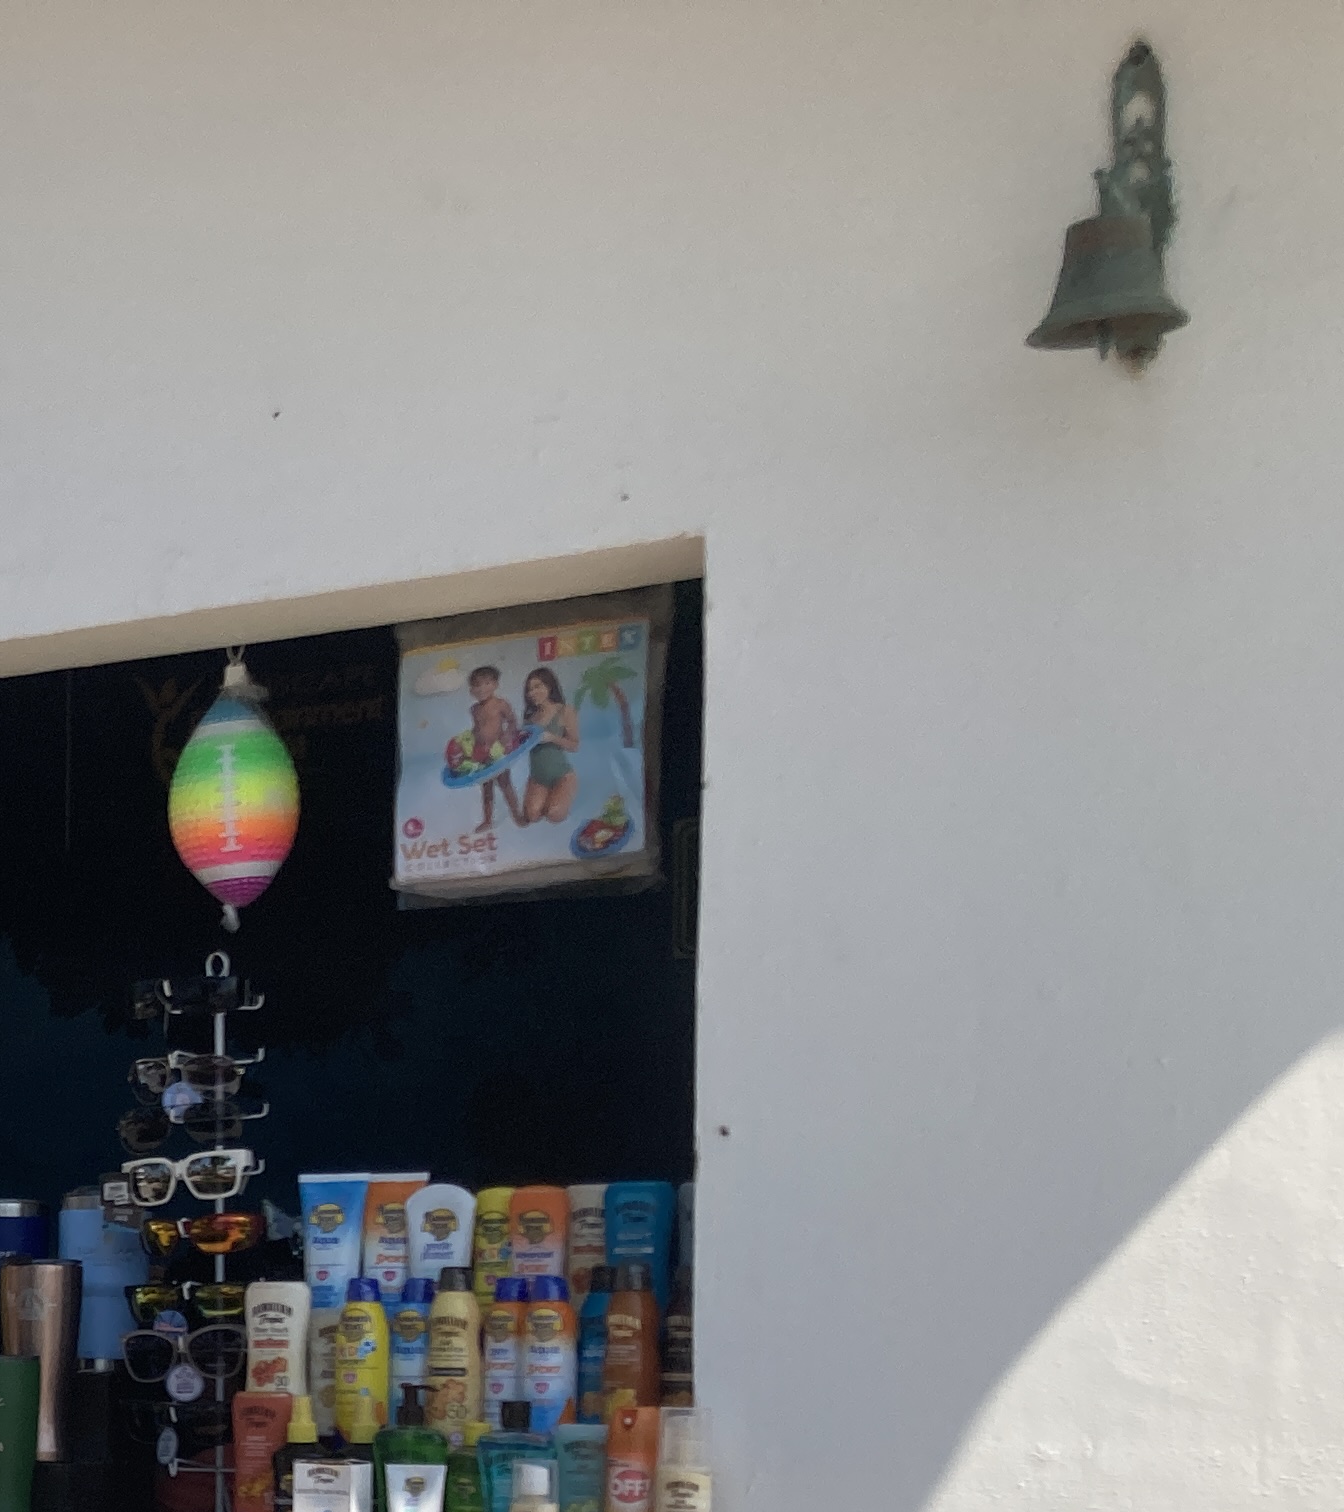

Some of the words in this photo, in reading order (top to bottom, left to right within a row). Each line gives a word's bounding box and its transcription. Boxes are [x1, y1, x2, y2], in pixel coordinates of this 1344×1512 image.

[400, 838, 451, 860] Wet
[457, 832, 498, 854] Set
[612, 1477, 650, 1497] OFF!
